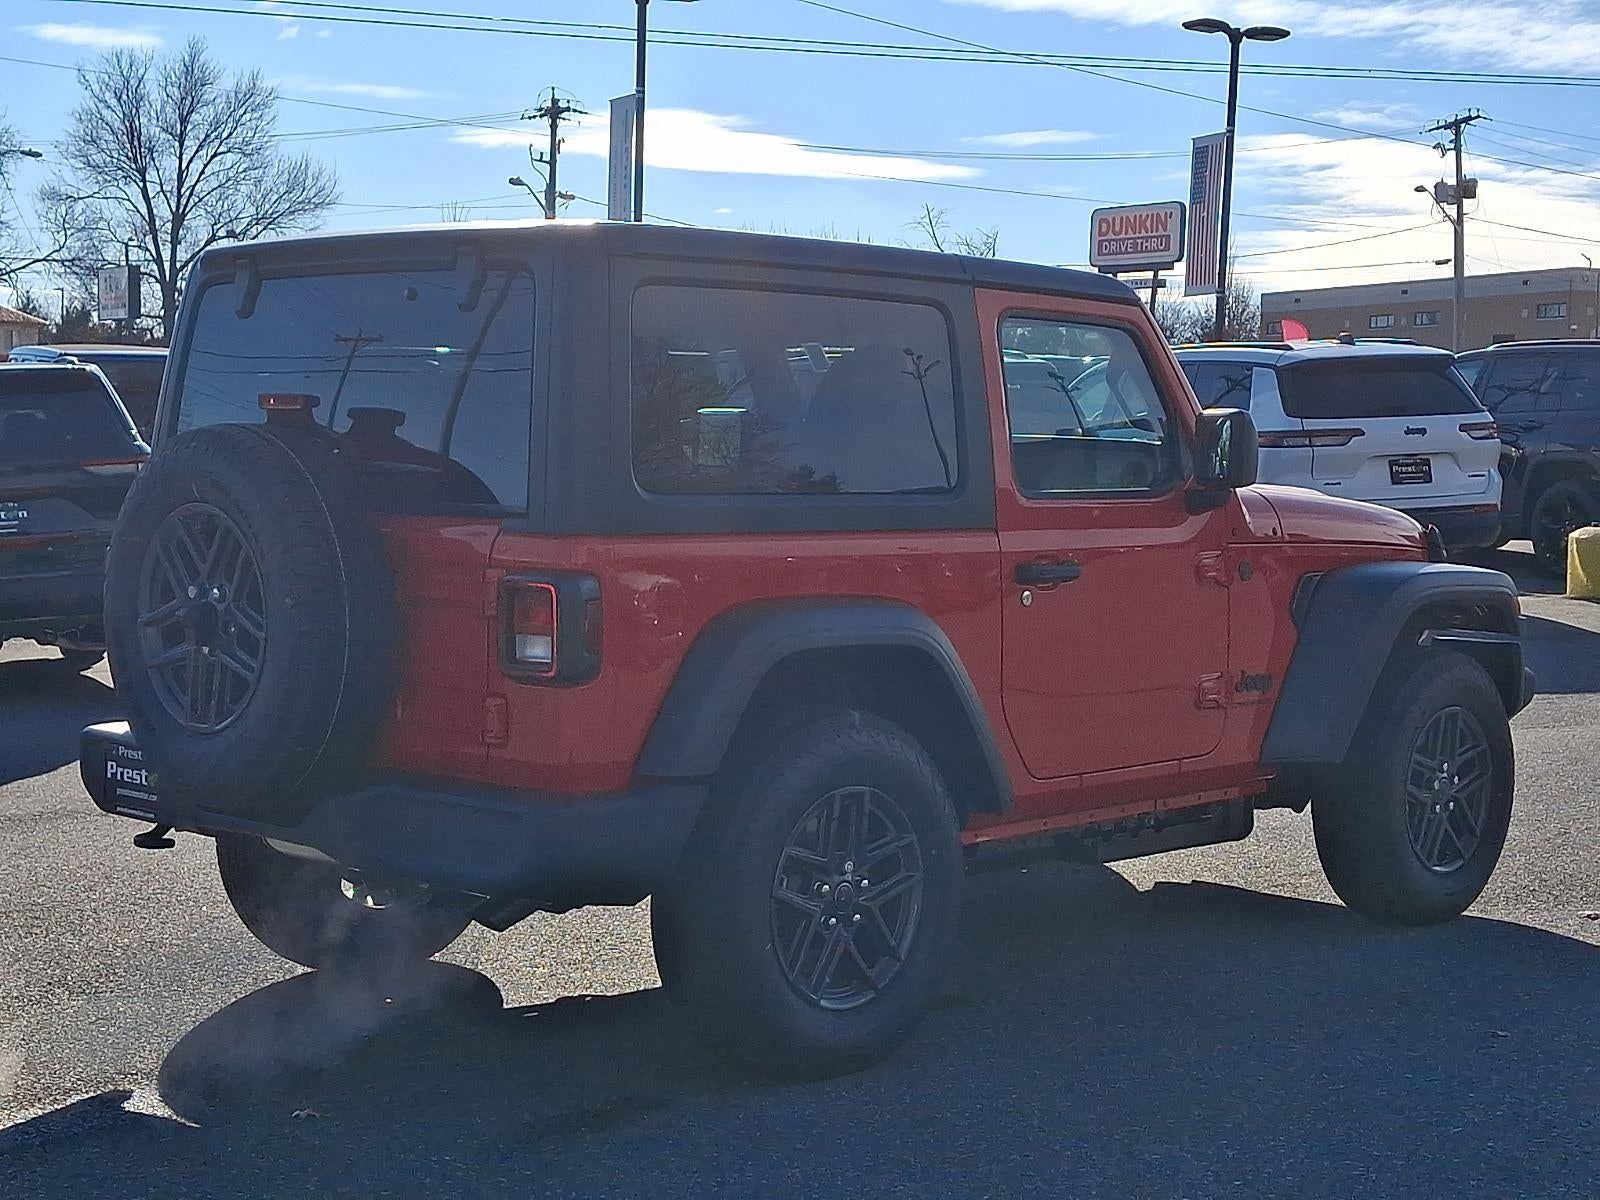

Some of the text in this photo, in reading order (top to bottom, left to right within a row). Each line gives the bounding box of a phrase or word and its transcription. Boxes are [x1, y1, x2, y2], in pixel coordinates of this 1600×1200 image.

[1098, 211, 1173, 237] DUNKIN'
[1102, 237, 1165, 254] DRIVE THRU
[1392, 465, 1429, 473] Prestn
